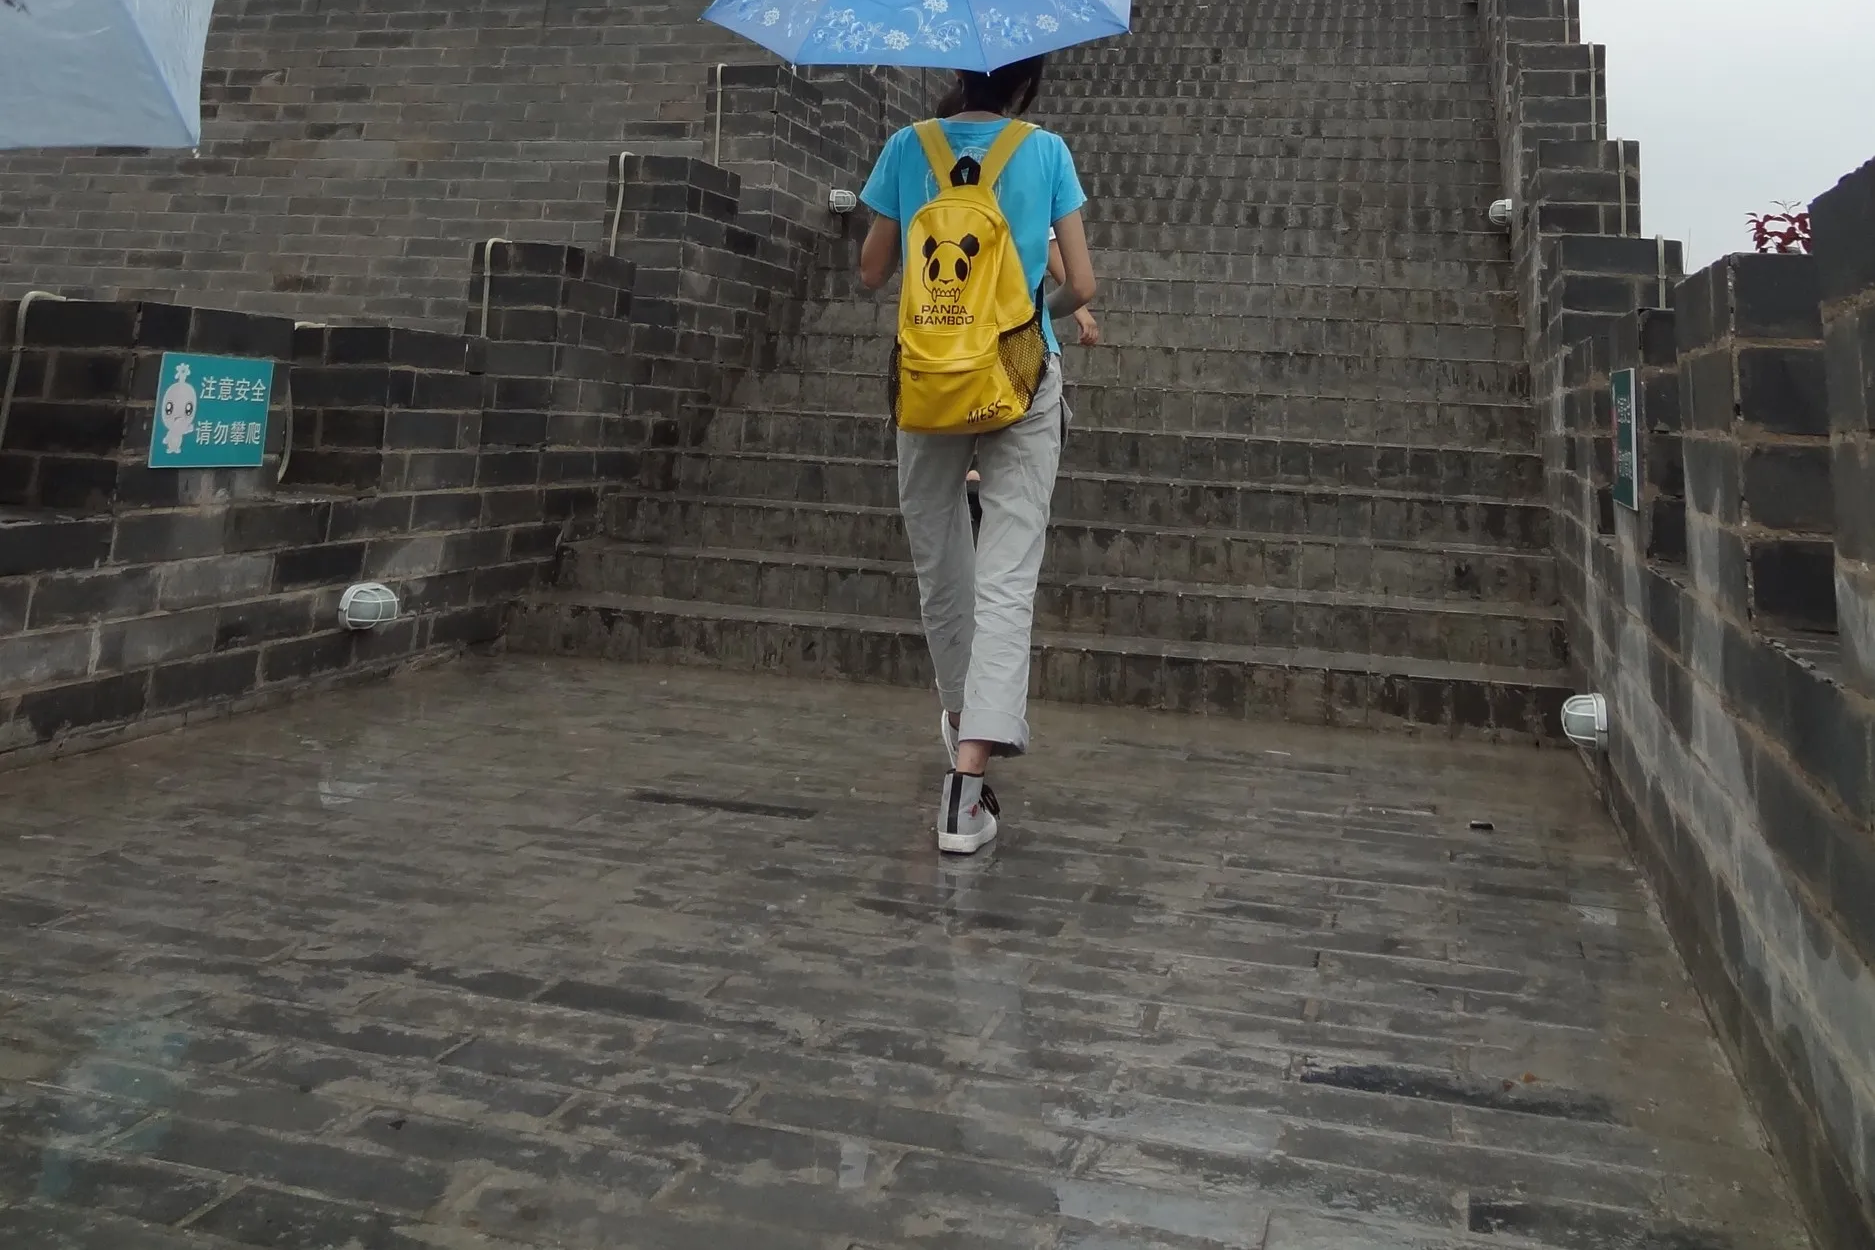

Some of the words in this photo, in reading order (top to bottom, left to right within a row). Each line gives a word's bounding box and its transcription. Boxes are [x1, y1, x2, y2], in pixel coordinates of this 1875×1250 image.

[921, 304, 968, 315] PANDA
[914, 315, 975, 326] BAMBOO
[200, 376, 266, 402] 注意安全
[195, 420, 261, 445] 请勿攀爬
